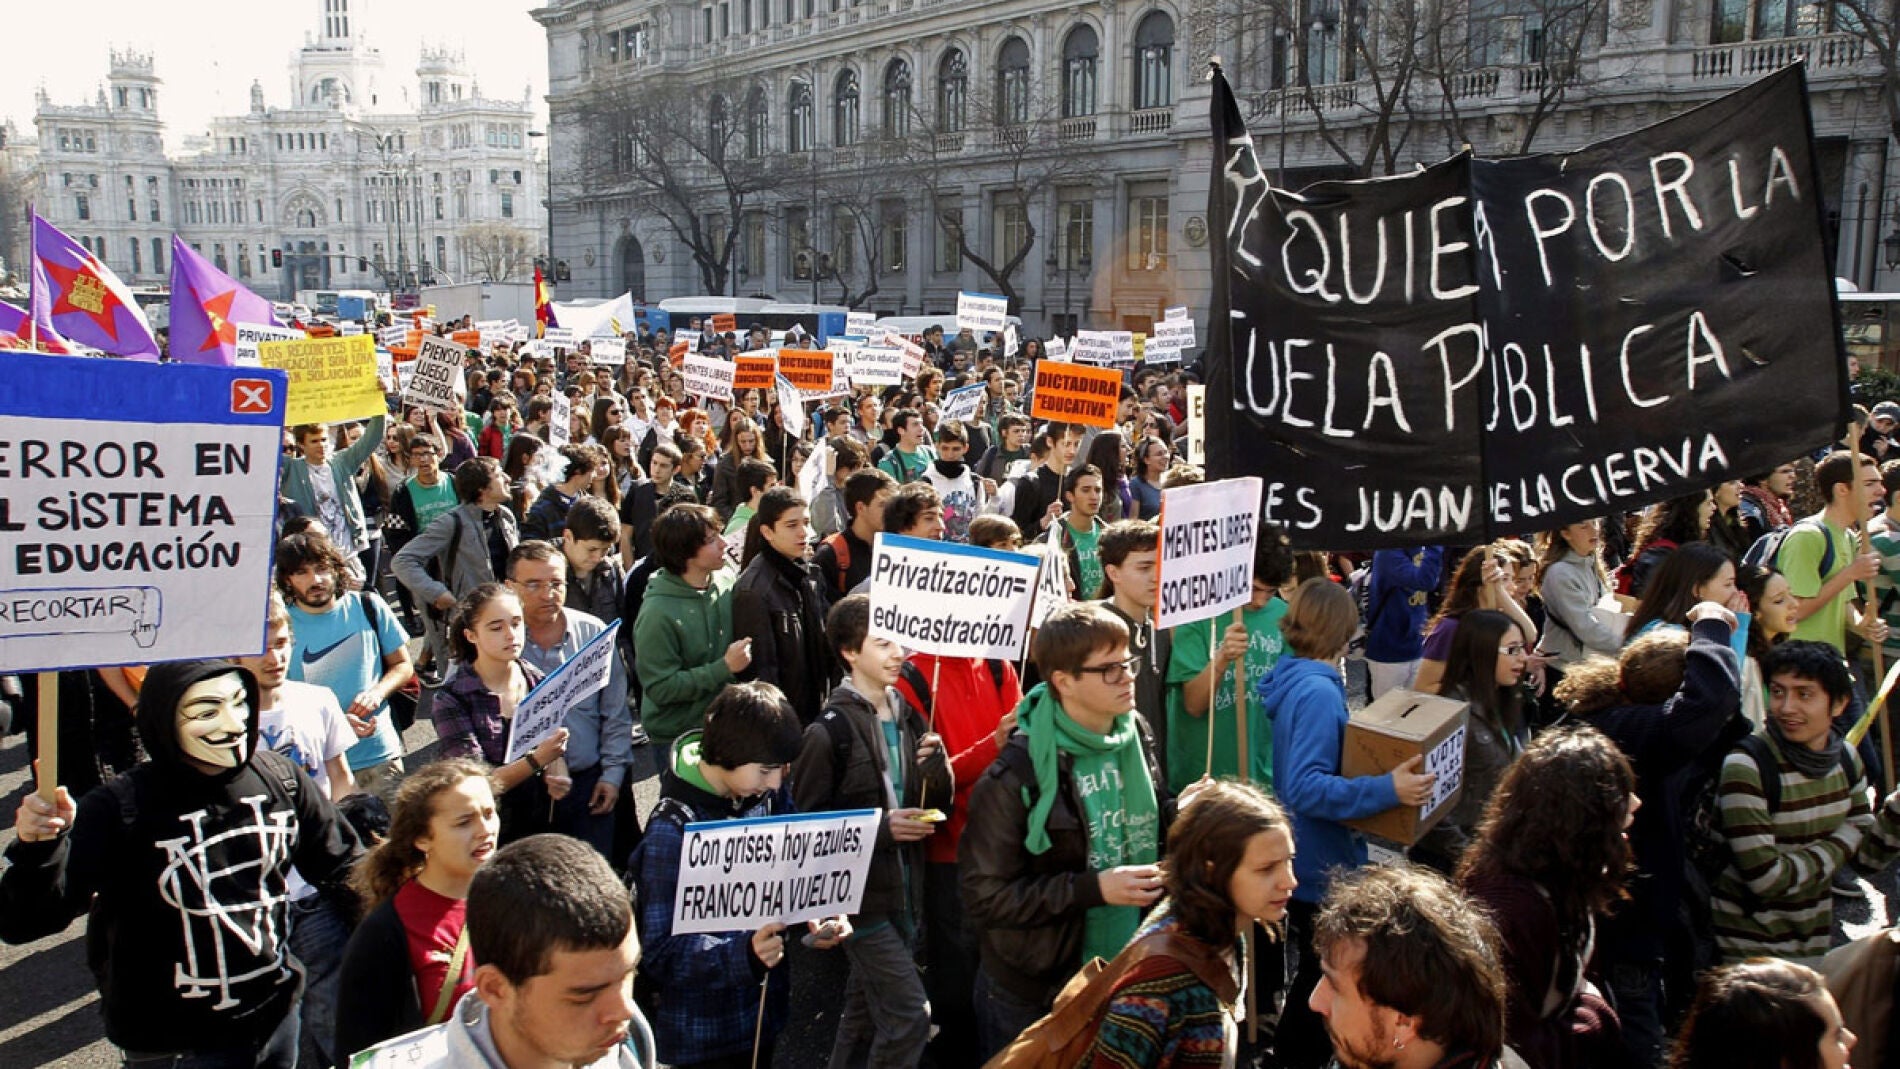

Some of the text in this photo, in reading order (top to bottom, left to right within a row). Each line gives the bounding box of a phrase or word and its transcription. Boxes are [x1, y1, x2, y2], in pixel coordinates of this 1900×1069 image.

[1524, 151, 1703, 288] POR
[1728, 145, 1800, 219] LA
[416, 360, 449, 382] LUEGO
[420, 341, 460, 366] PIENSO
[1037, 372, 1117, 397] DICTADURA
[194, 442, 251, 476] EN
[1345, 484, 1473, 532] JUAN
[1519, 473, 1556, 516] LA
[1561, 432, 1730, 505] CIERVA
[1163, 518, 1218, 562] MENTES
[1162, 563, 1249, 616] SOCIEDAD LAICA
[874, 604, 1017, 647] educastración.
[688, 819, 863, 874] Con grises, hoy azules,
[681, 869, 852, 920] FRANCO HA VUELTO.
